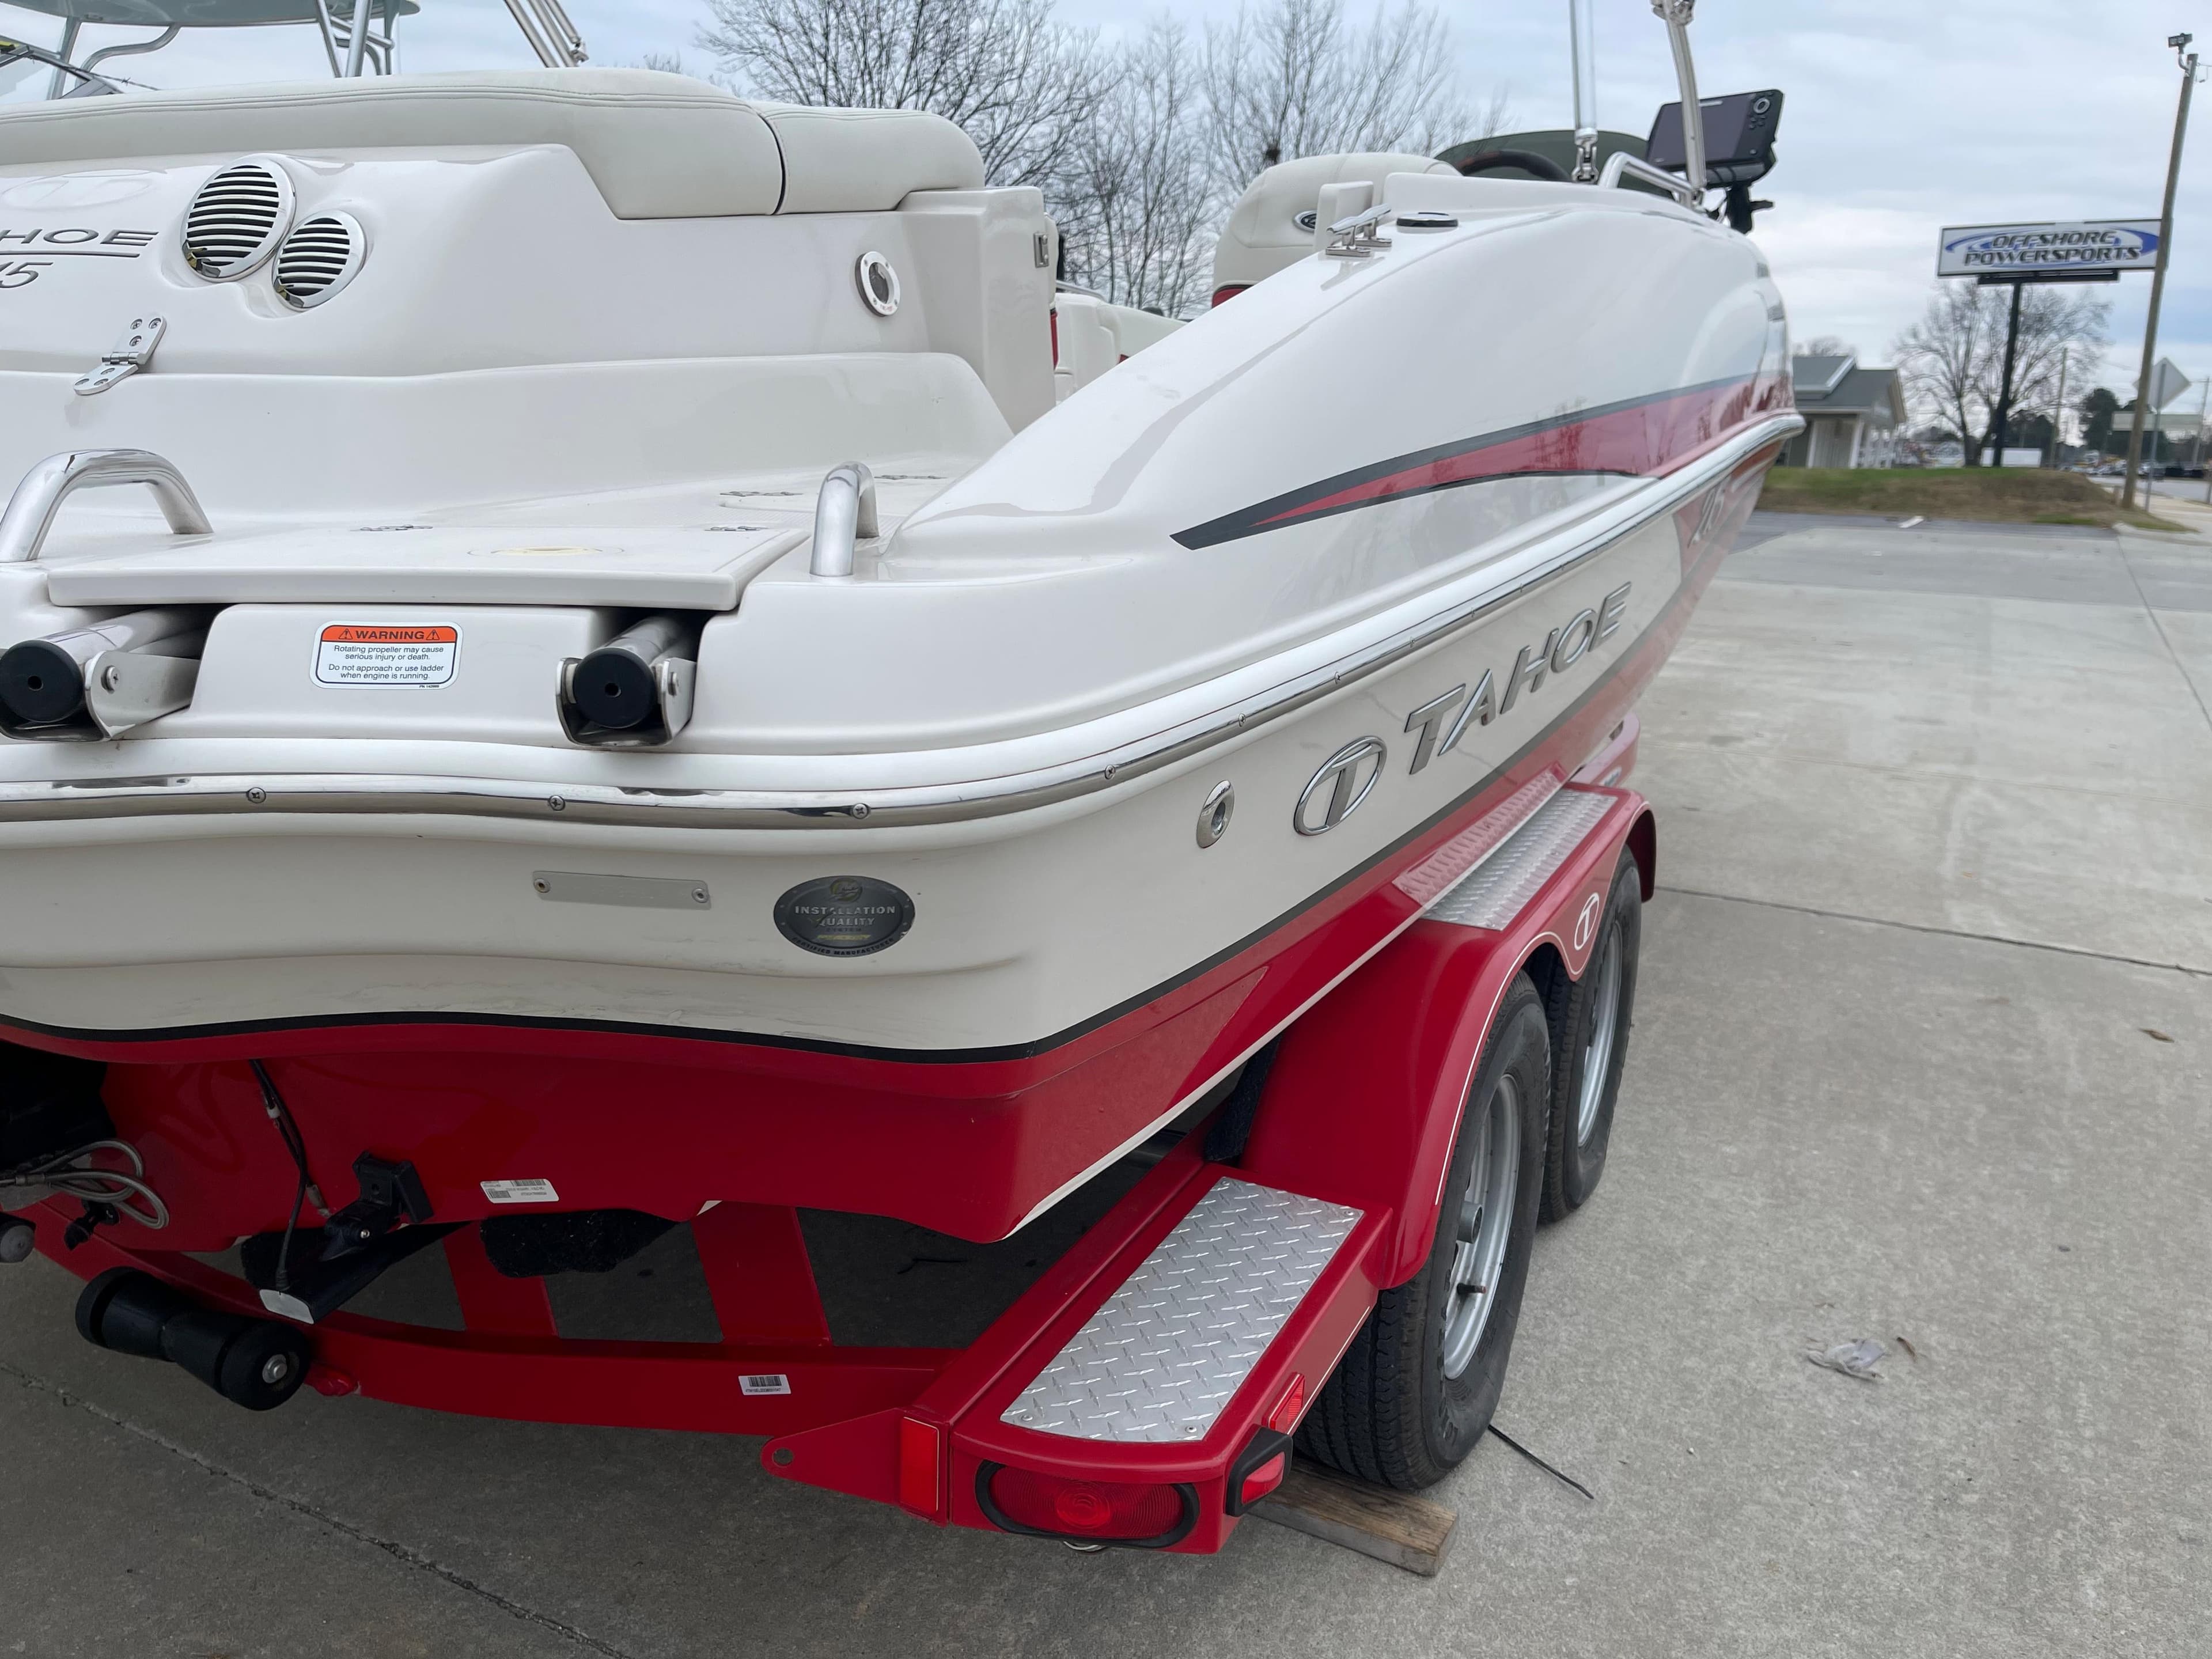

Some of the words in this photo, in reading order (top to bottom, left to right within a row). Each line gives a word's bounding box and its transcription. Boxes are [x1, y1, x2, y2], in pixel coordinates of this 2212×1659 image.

[1992, 230, 2119, 248] OFFSHORE
[1963, 246, 2142, 266] POWERSPORTS
[355, 630, 425, 639] WARNING
[368, 646, 402, 654] propeller
[357, 665, 393, 673] approach
[363, 672, 389, 680] engine
[1404, 581, 1632, 775] TAHOE
